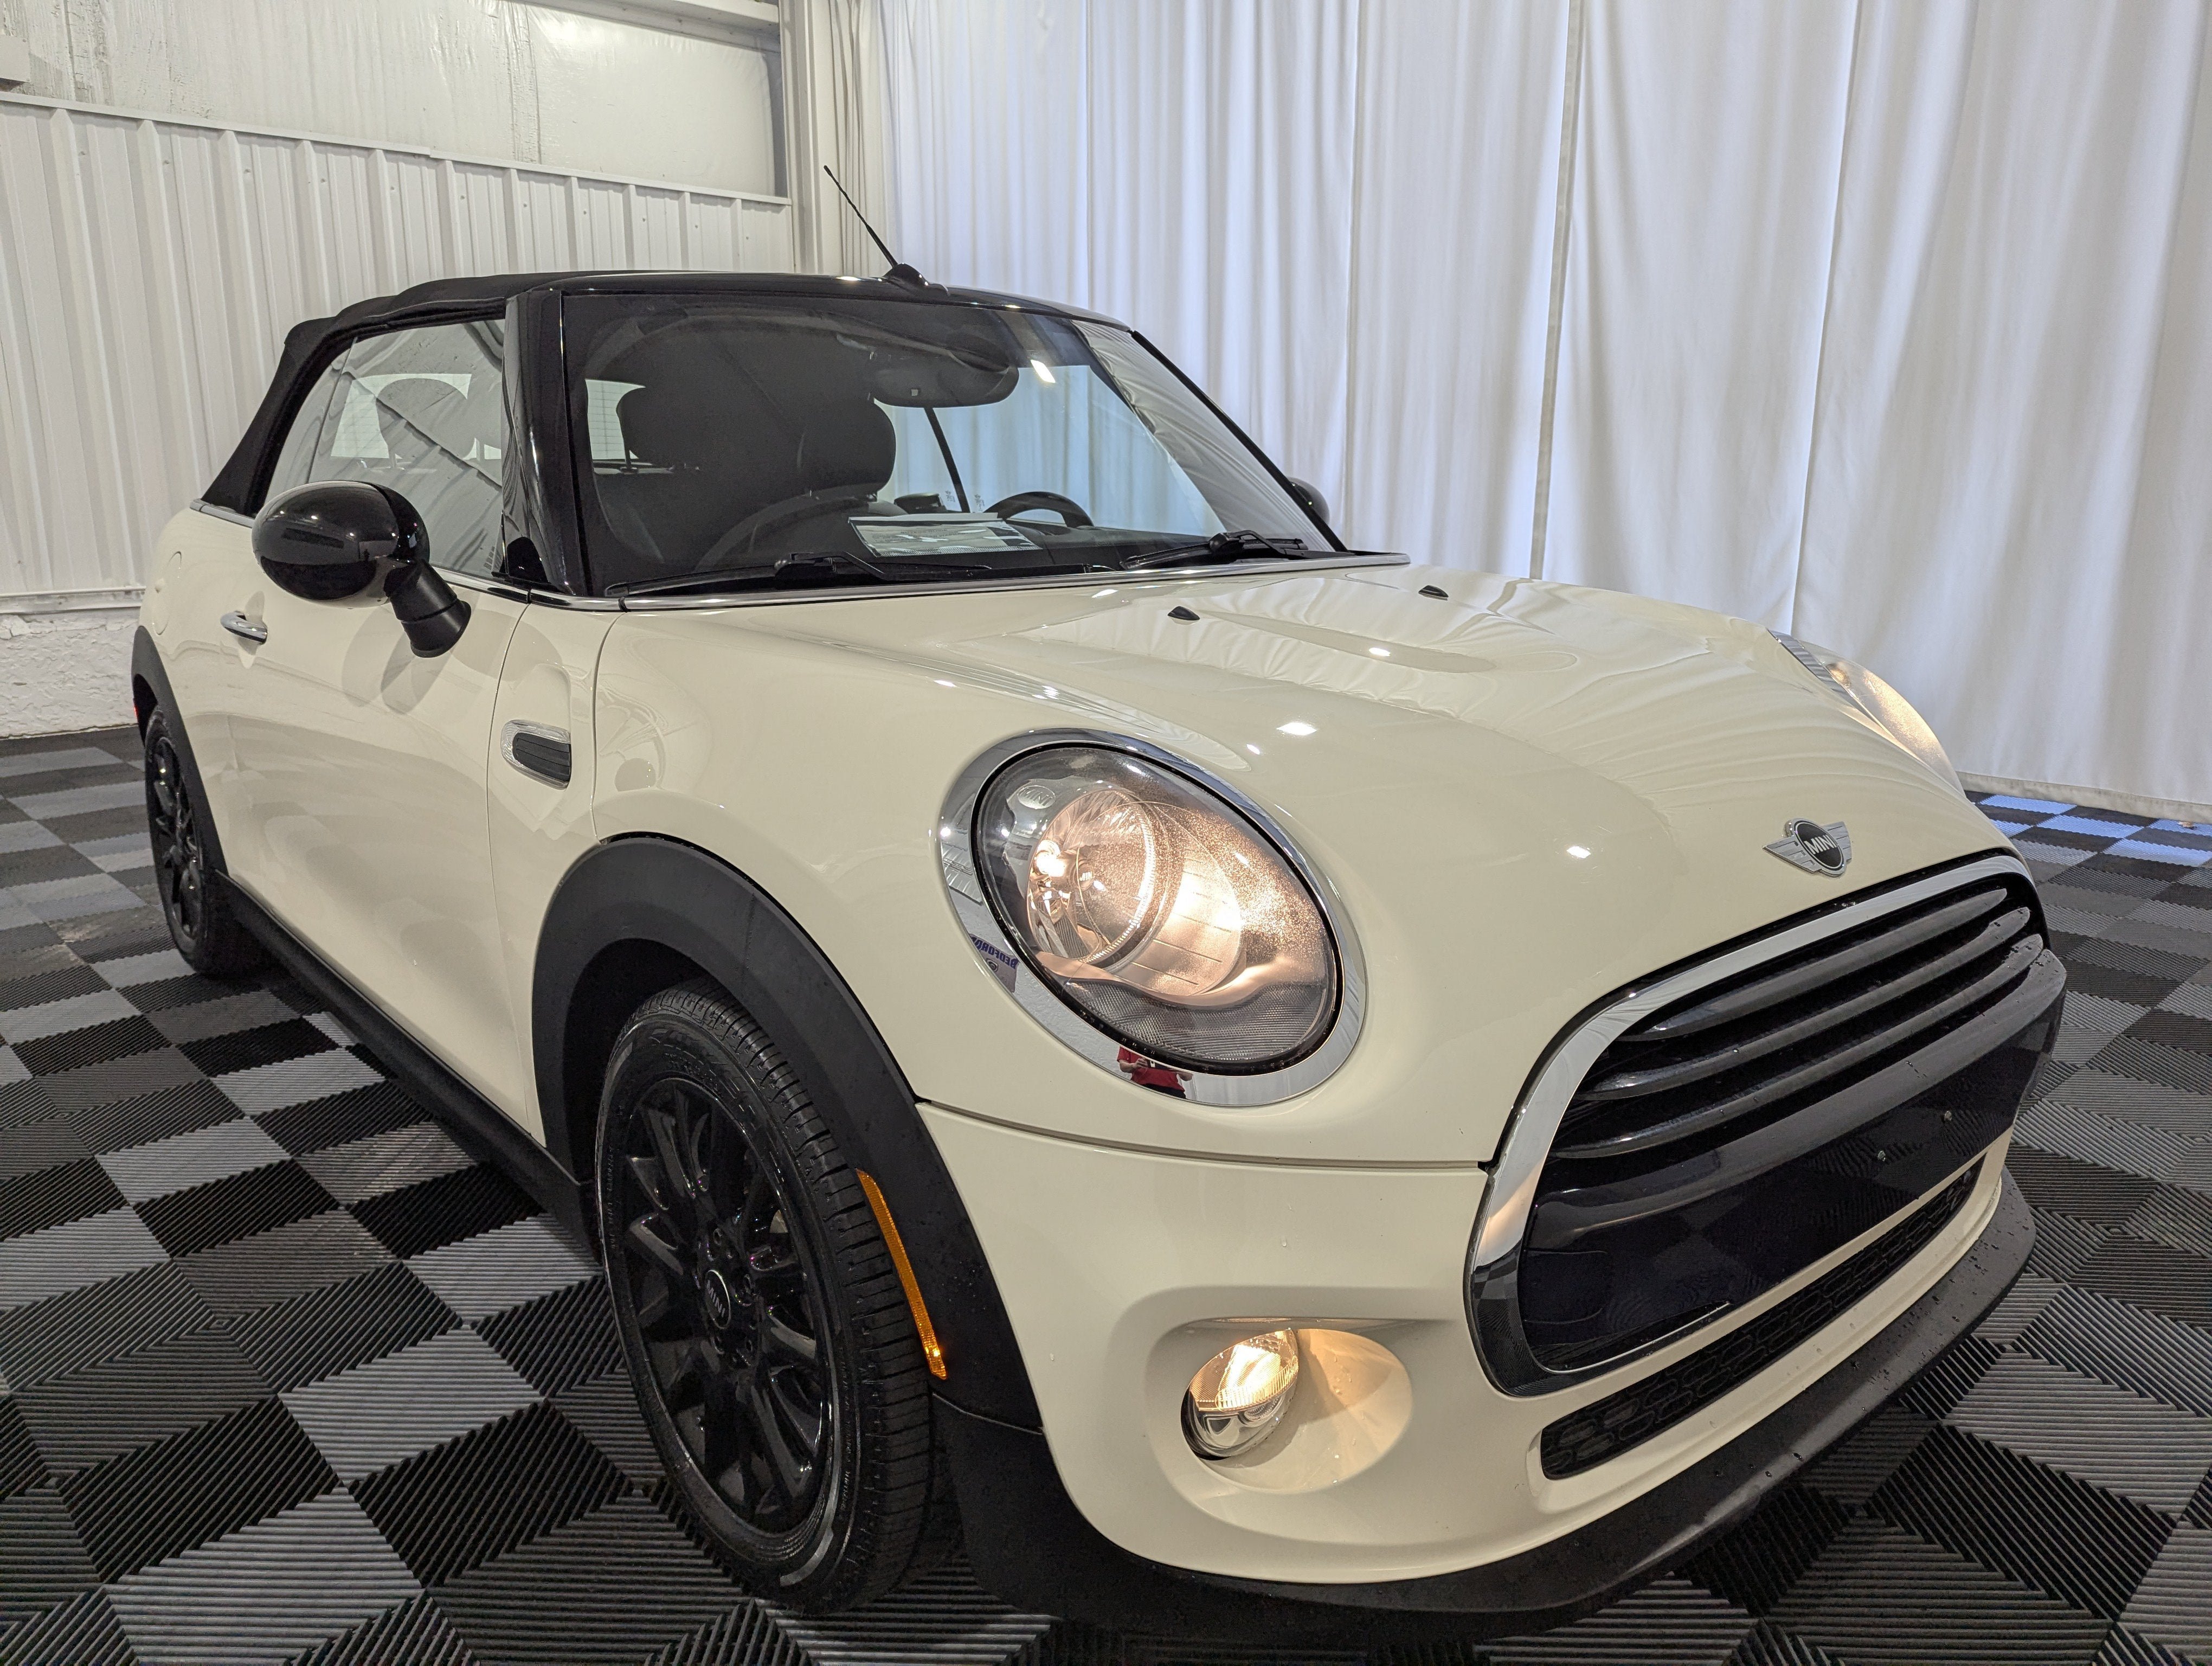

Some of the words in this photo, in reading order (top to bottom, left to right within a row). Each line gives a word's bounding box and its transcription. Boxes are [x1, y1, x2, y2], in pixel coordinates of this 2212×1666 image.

[1019, 787, 1053, 806] MINI
[1803, 834, 1838, 855] MINI
[706, 1279, 726, 1318] MINI
